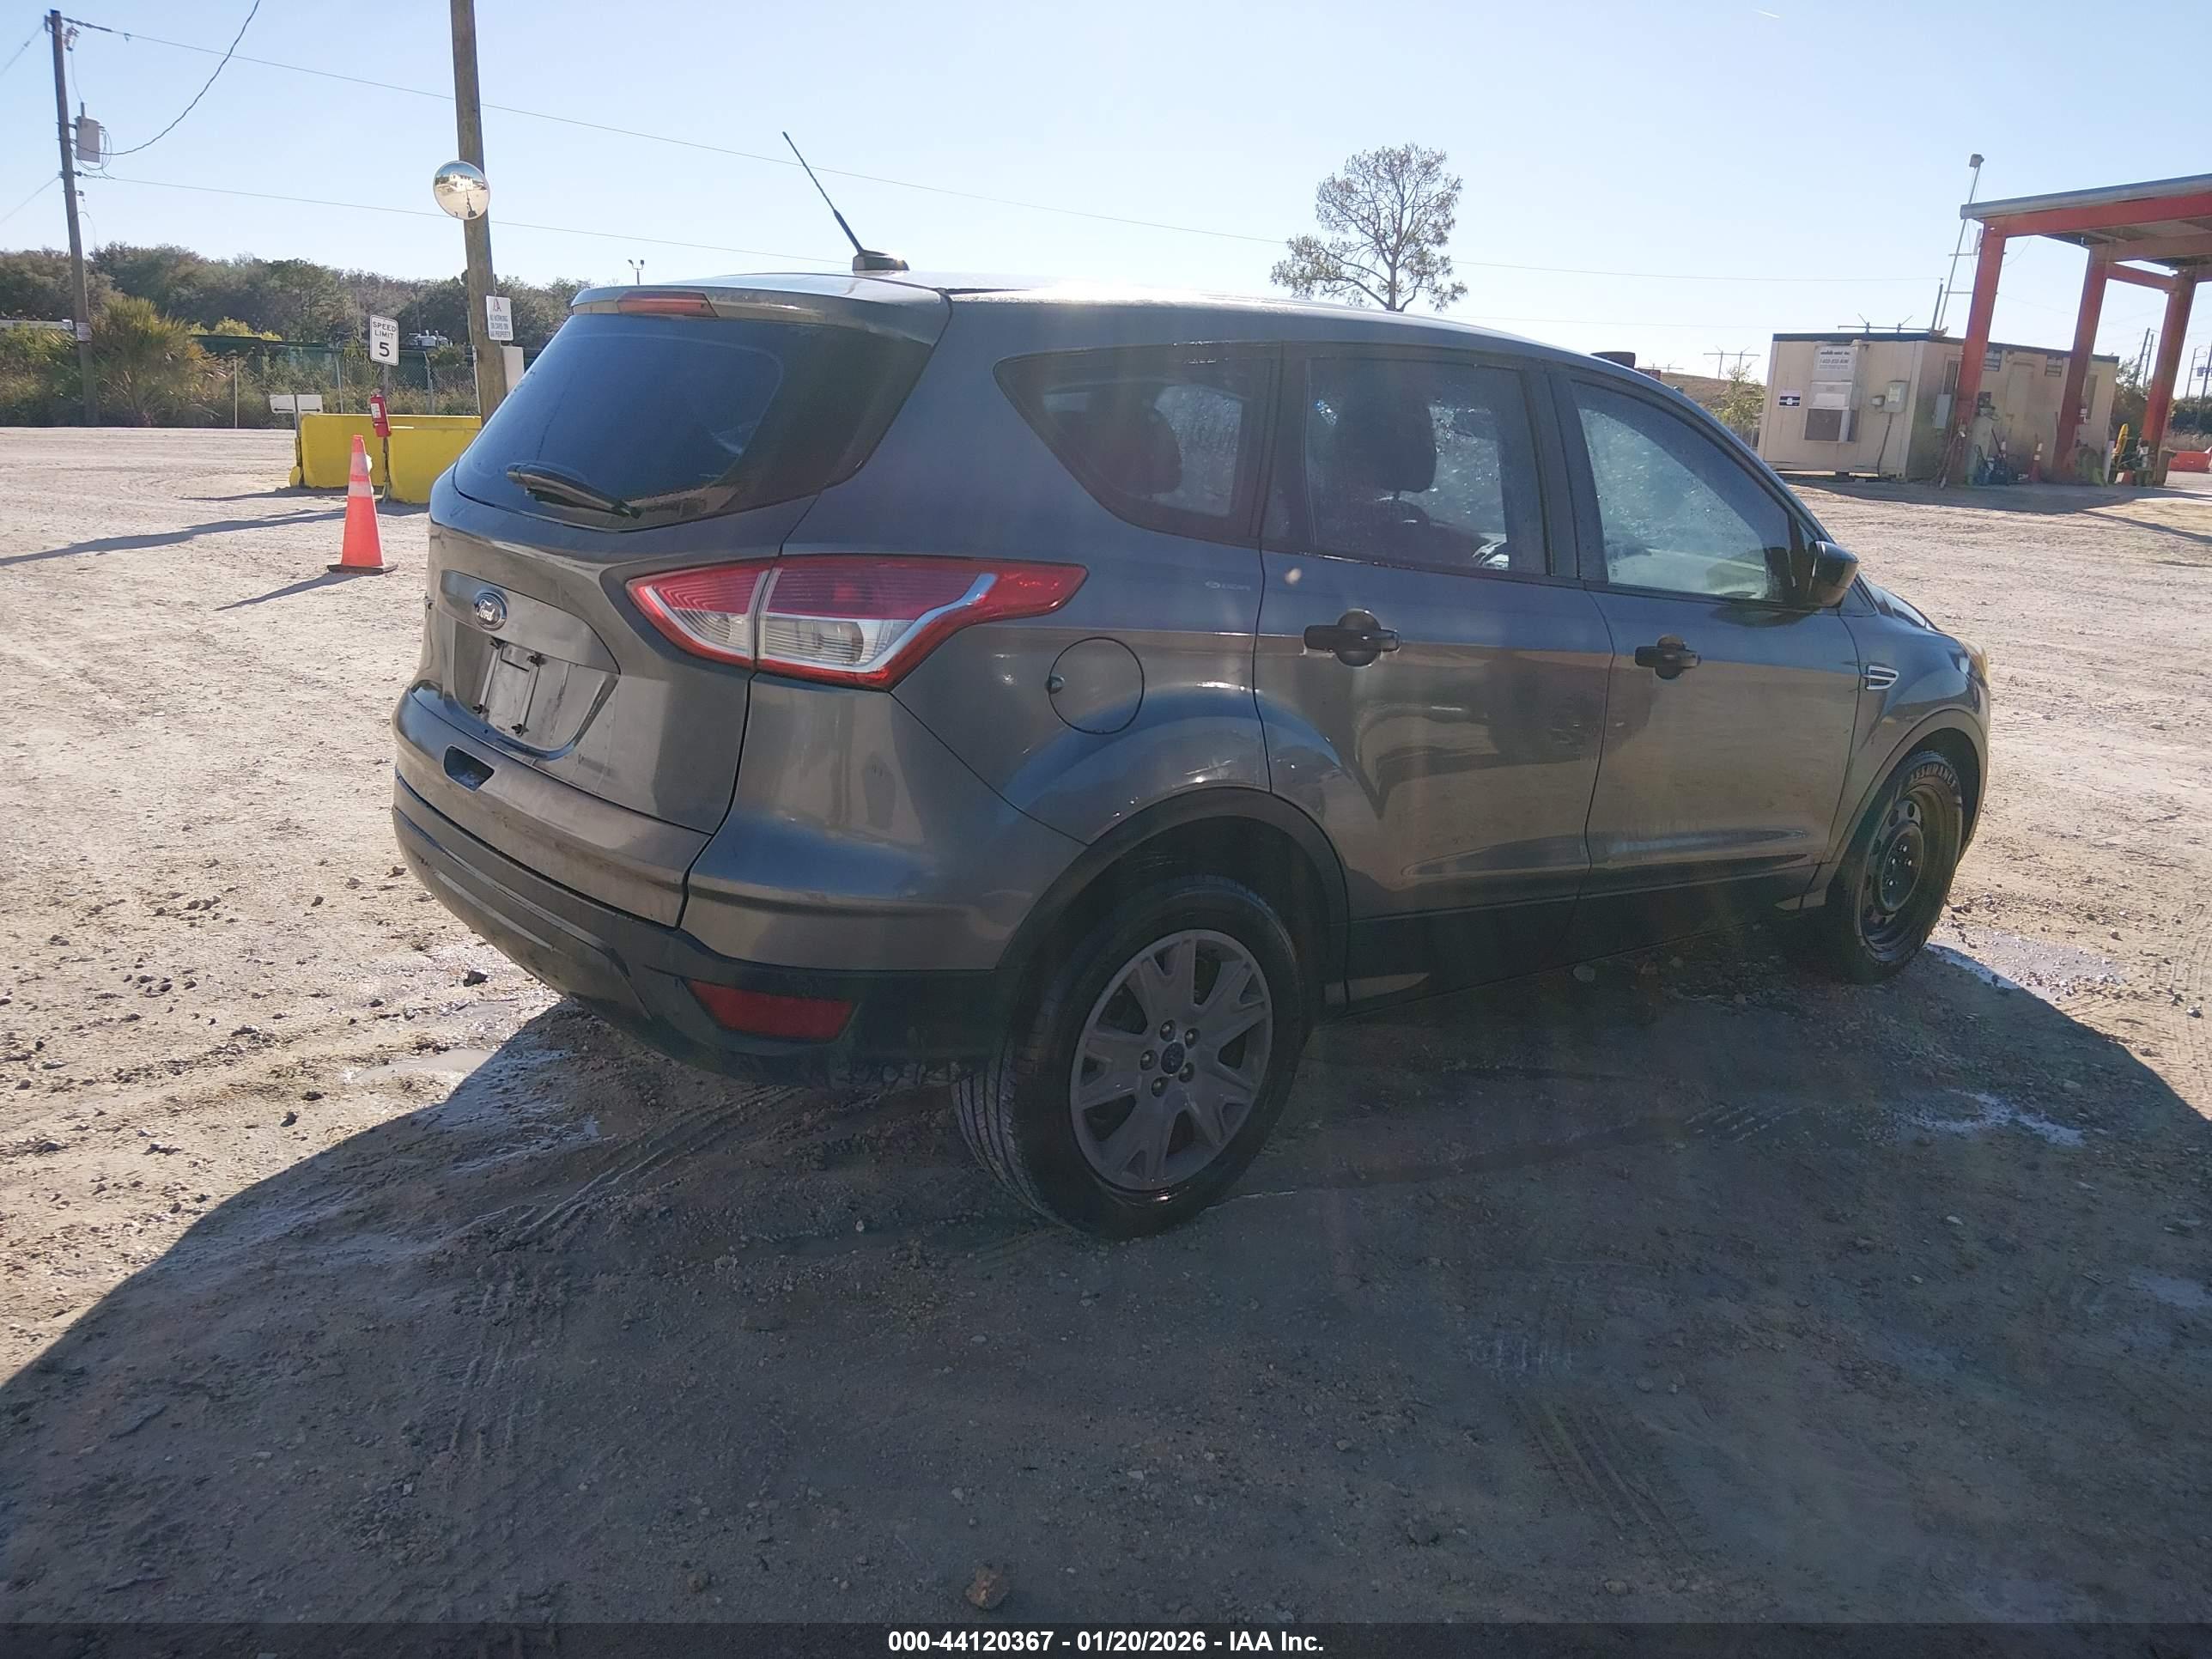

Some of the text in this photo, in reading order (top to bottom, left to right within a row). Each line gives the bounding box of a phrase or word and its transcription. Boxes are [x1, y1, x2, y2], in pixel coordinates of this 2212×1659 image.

[373, 321, 397, 332] SPEED
[374, 330, 394, 339] LIMIT
[379, 342, 390, 357] 5
[475, 599, 495, 622] Ford
